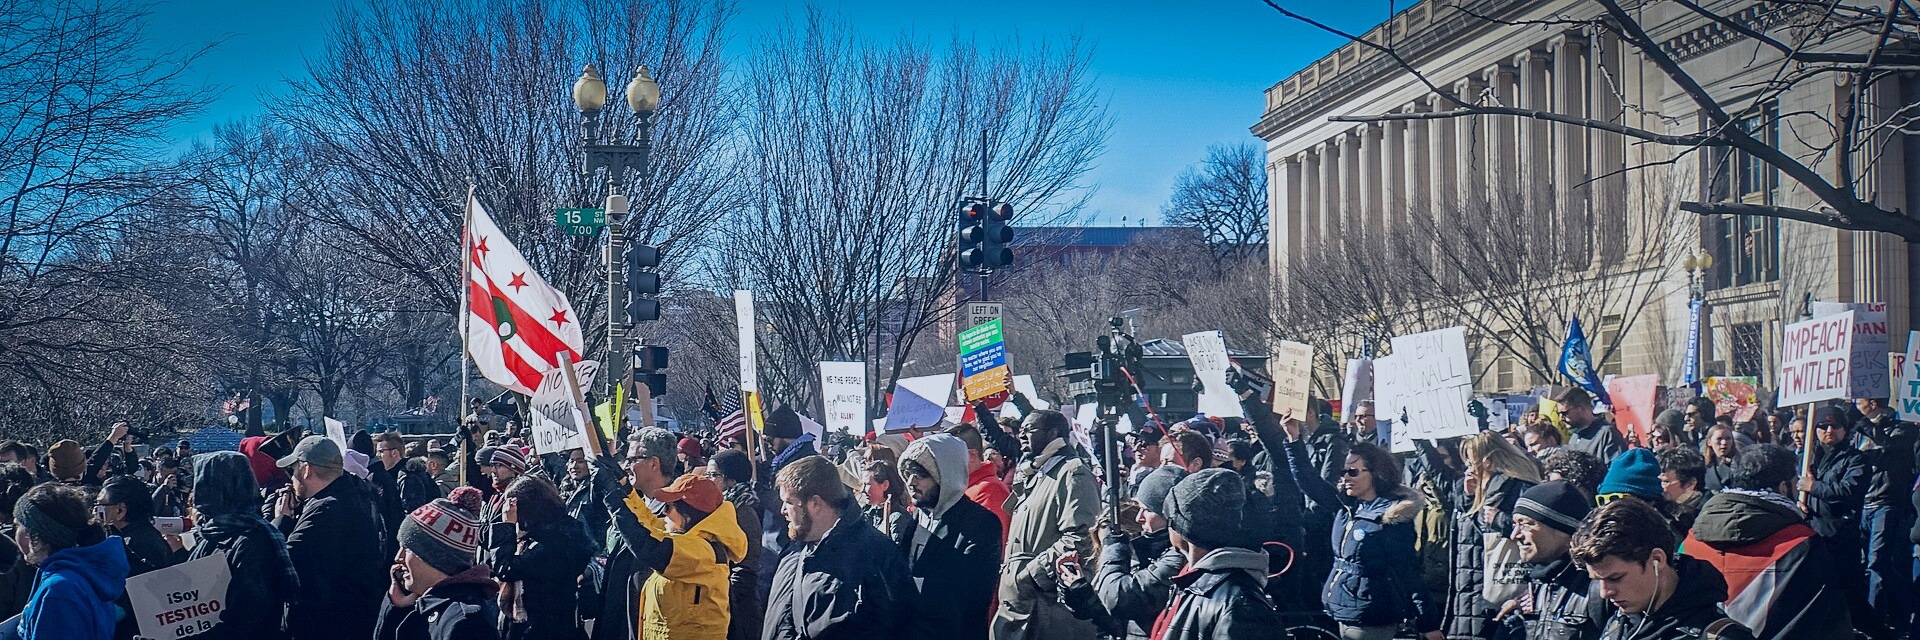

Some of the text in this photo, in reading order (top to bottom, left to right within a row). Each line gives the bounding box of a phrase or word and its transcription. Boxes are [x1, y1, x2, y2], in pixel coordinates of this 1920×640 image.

[564, 211, 581, 224] 15
[572, 226, 592, 235] 700
[972, 305, 999, 315] LEFT ON
[1415, 333, 1443, 360] BAN
[1784, 318, 1848, 363] IMPEACH
[834, 376, 844, 385] THE
[845, 376, 861, 385] PEOPLE
[1421, 357, 1462, 388] WALL
[1783, 357, 1845, 399] TWITLER
[536, 399, 571, 426] NO FEA
[1405, 383, 1473, 434] RESIST
[540, 431, 552, 447] NO
[156, 600, 221, 626] TESTIGO
[175, 619, 212, 637] de la
